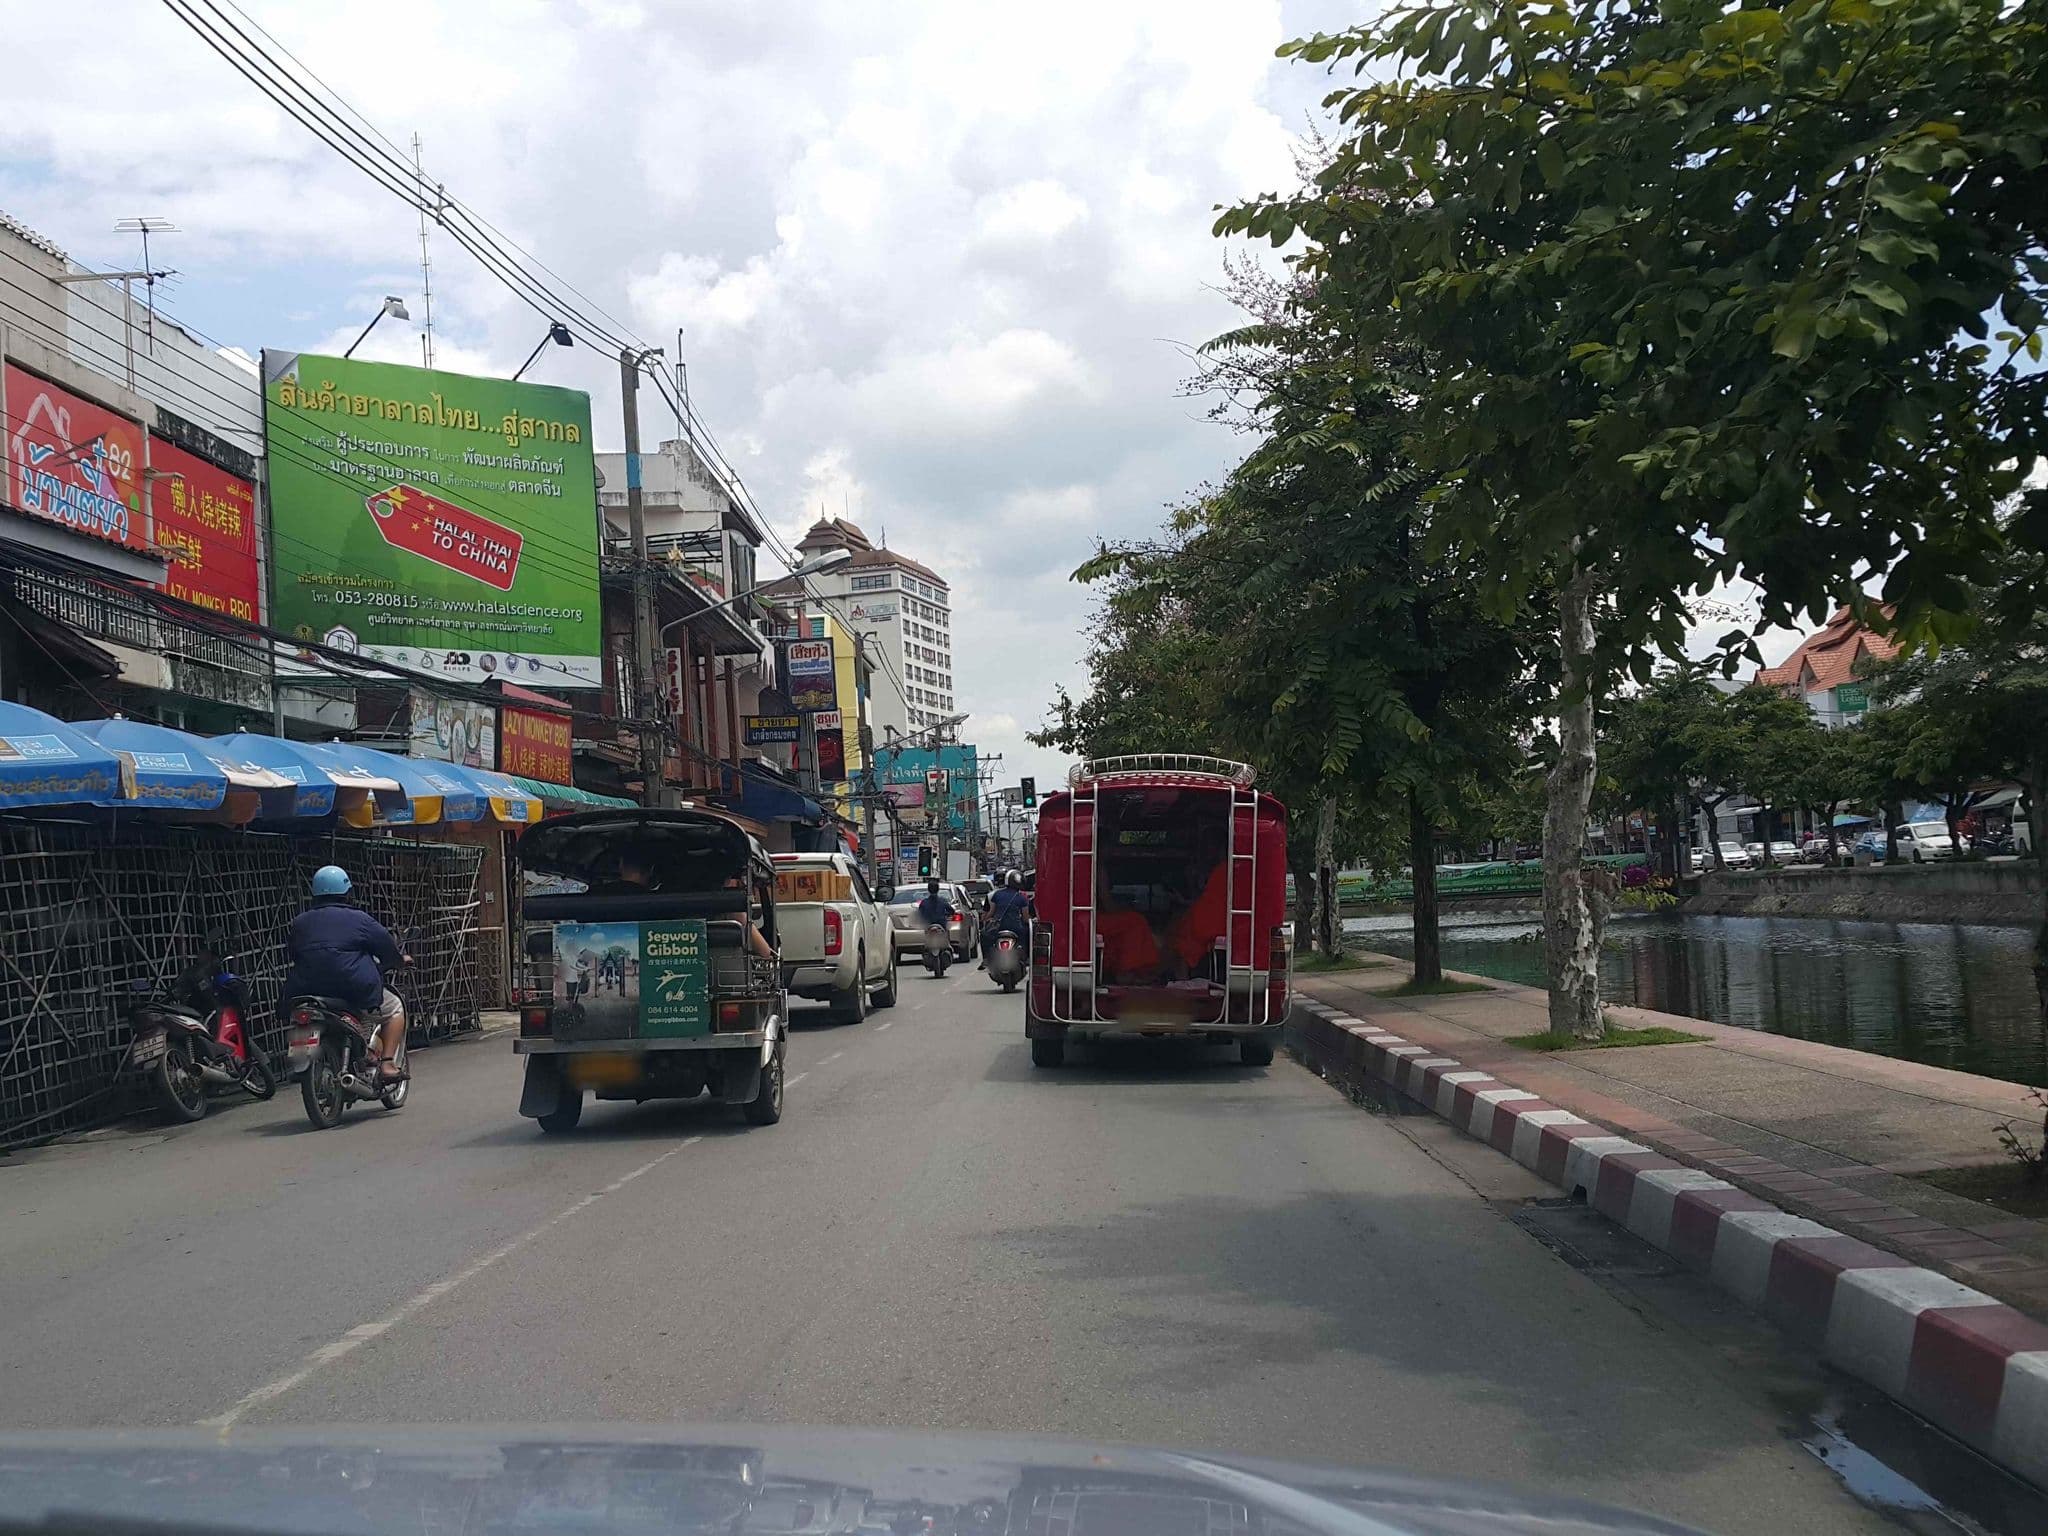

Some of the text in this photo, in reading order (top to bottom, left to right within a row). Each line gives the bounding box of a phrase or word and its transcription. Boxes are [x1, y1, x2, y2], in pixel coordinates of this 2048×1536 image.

[108, 443, 131, 480] 82
[336, 431, 430, 458] ผู้ประกอบการ
[462, 447, 564, 475] พัฒนาผลิตภัณฑ์
[508, 478, 561, 496] ตลาดจีน
[432, 531, 508, 573] TO CHINA
[434, 518, 512, 559] HALAL THAI
[335, 590, 418, 608] 053-280815
[442, 599, 583, 623] www.halalscience.org
[668, 650, 680, 712] SPICY
[503, 707, 568, 748] LAZY MONKEY BBQ
[22, 747, 69, 756] Choice
[140, 760, 185, 768] Choice
[646, 943, 699, 956] Gibbon
[647, 930, 698, 944] Segway
[647, 1006, 662, 1014] 084
[679, 1005, 698, 1013] 4004
